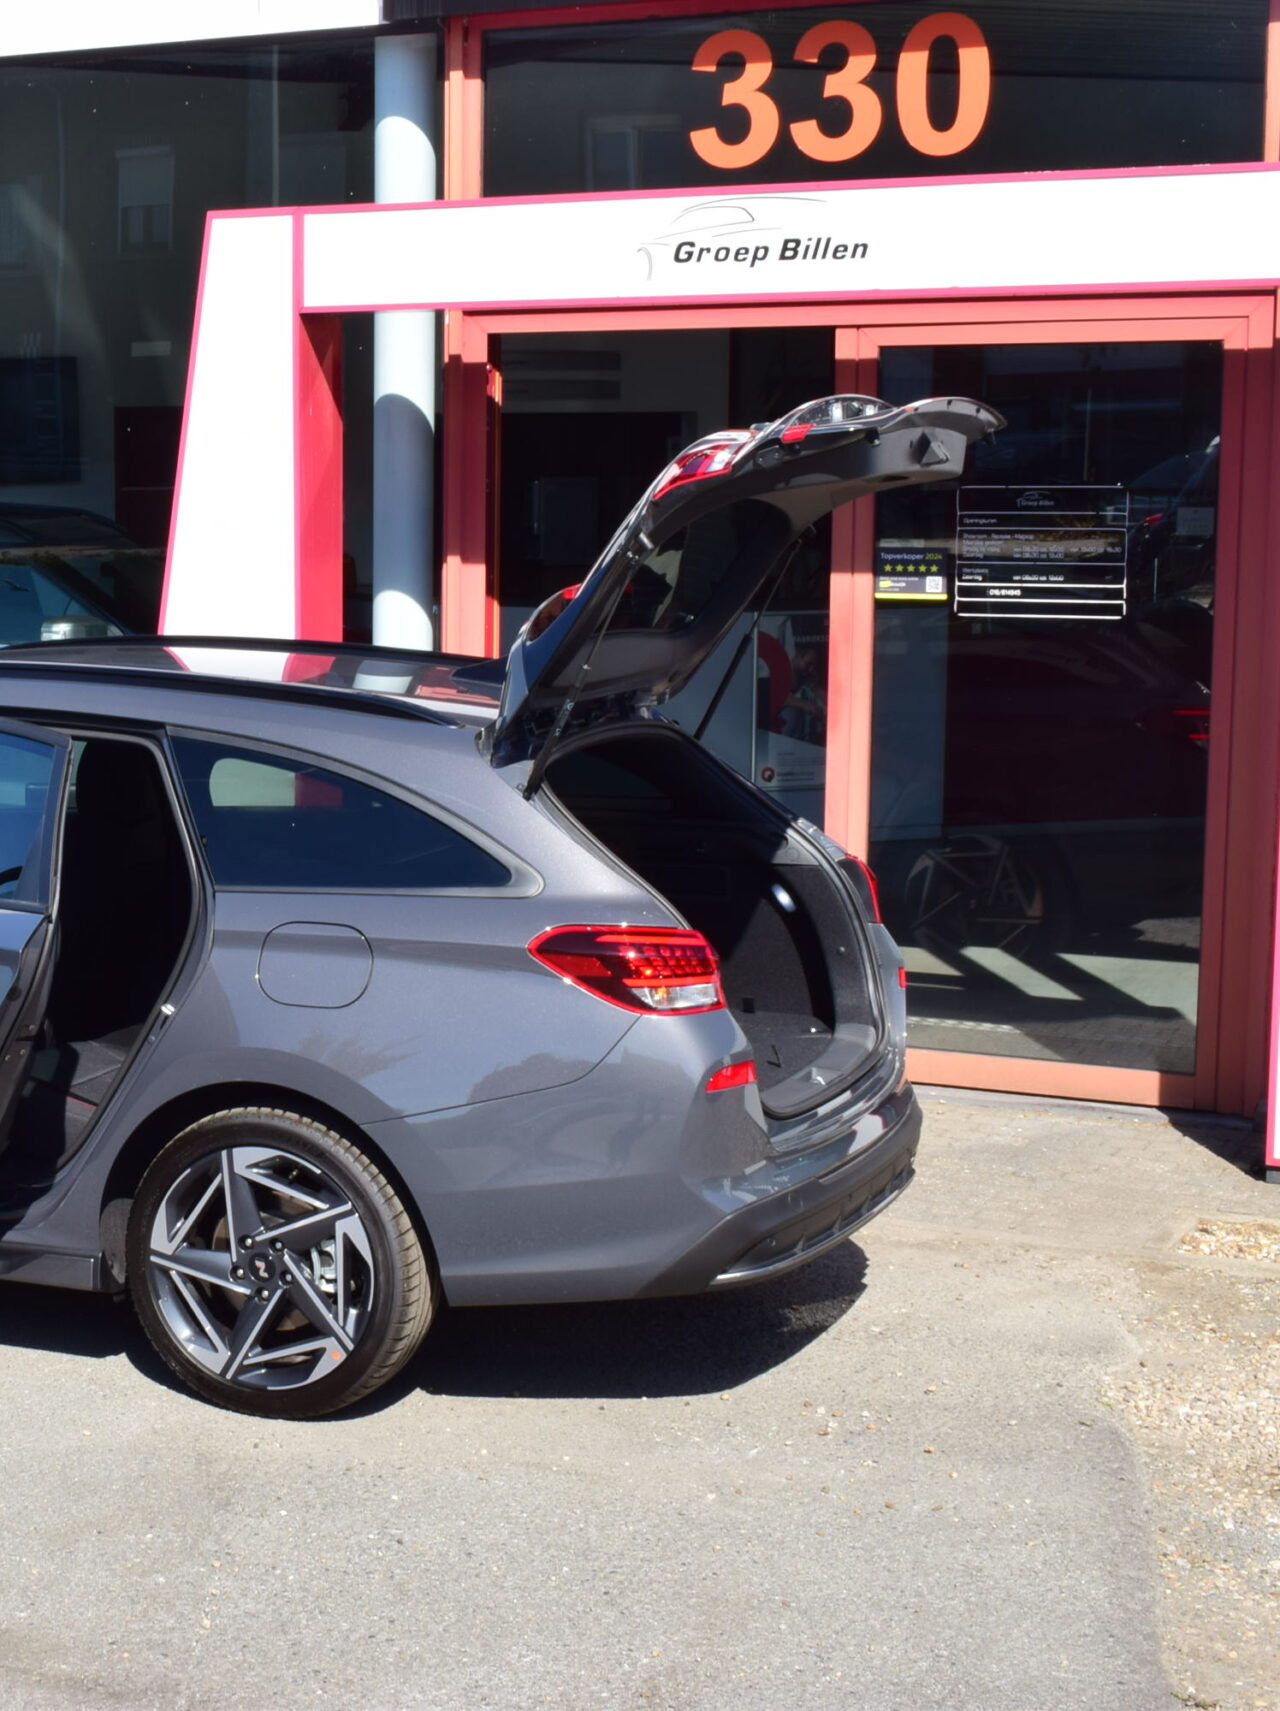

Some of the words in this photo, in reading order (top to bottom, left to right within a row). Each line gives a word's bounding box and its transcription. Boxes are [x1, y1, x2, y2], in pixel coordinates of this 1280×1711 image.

[689, 11, 992, 170] 330
[673, 239, 770, 268] Groep
[778, 235, 869, 263] Billen
[880, 552, 924, 560] Topverkoper
[925, 552, 943, 560] 2024
